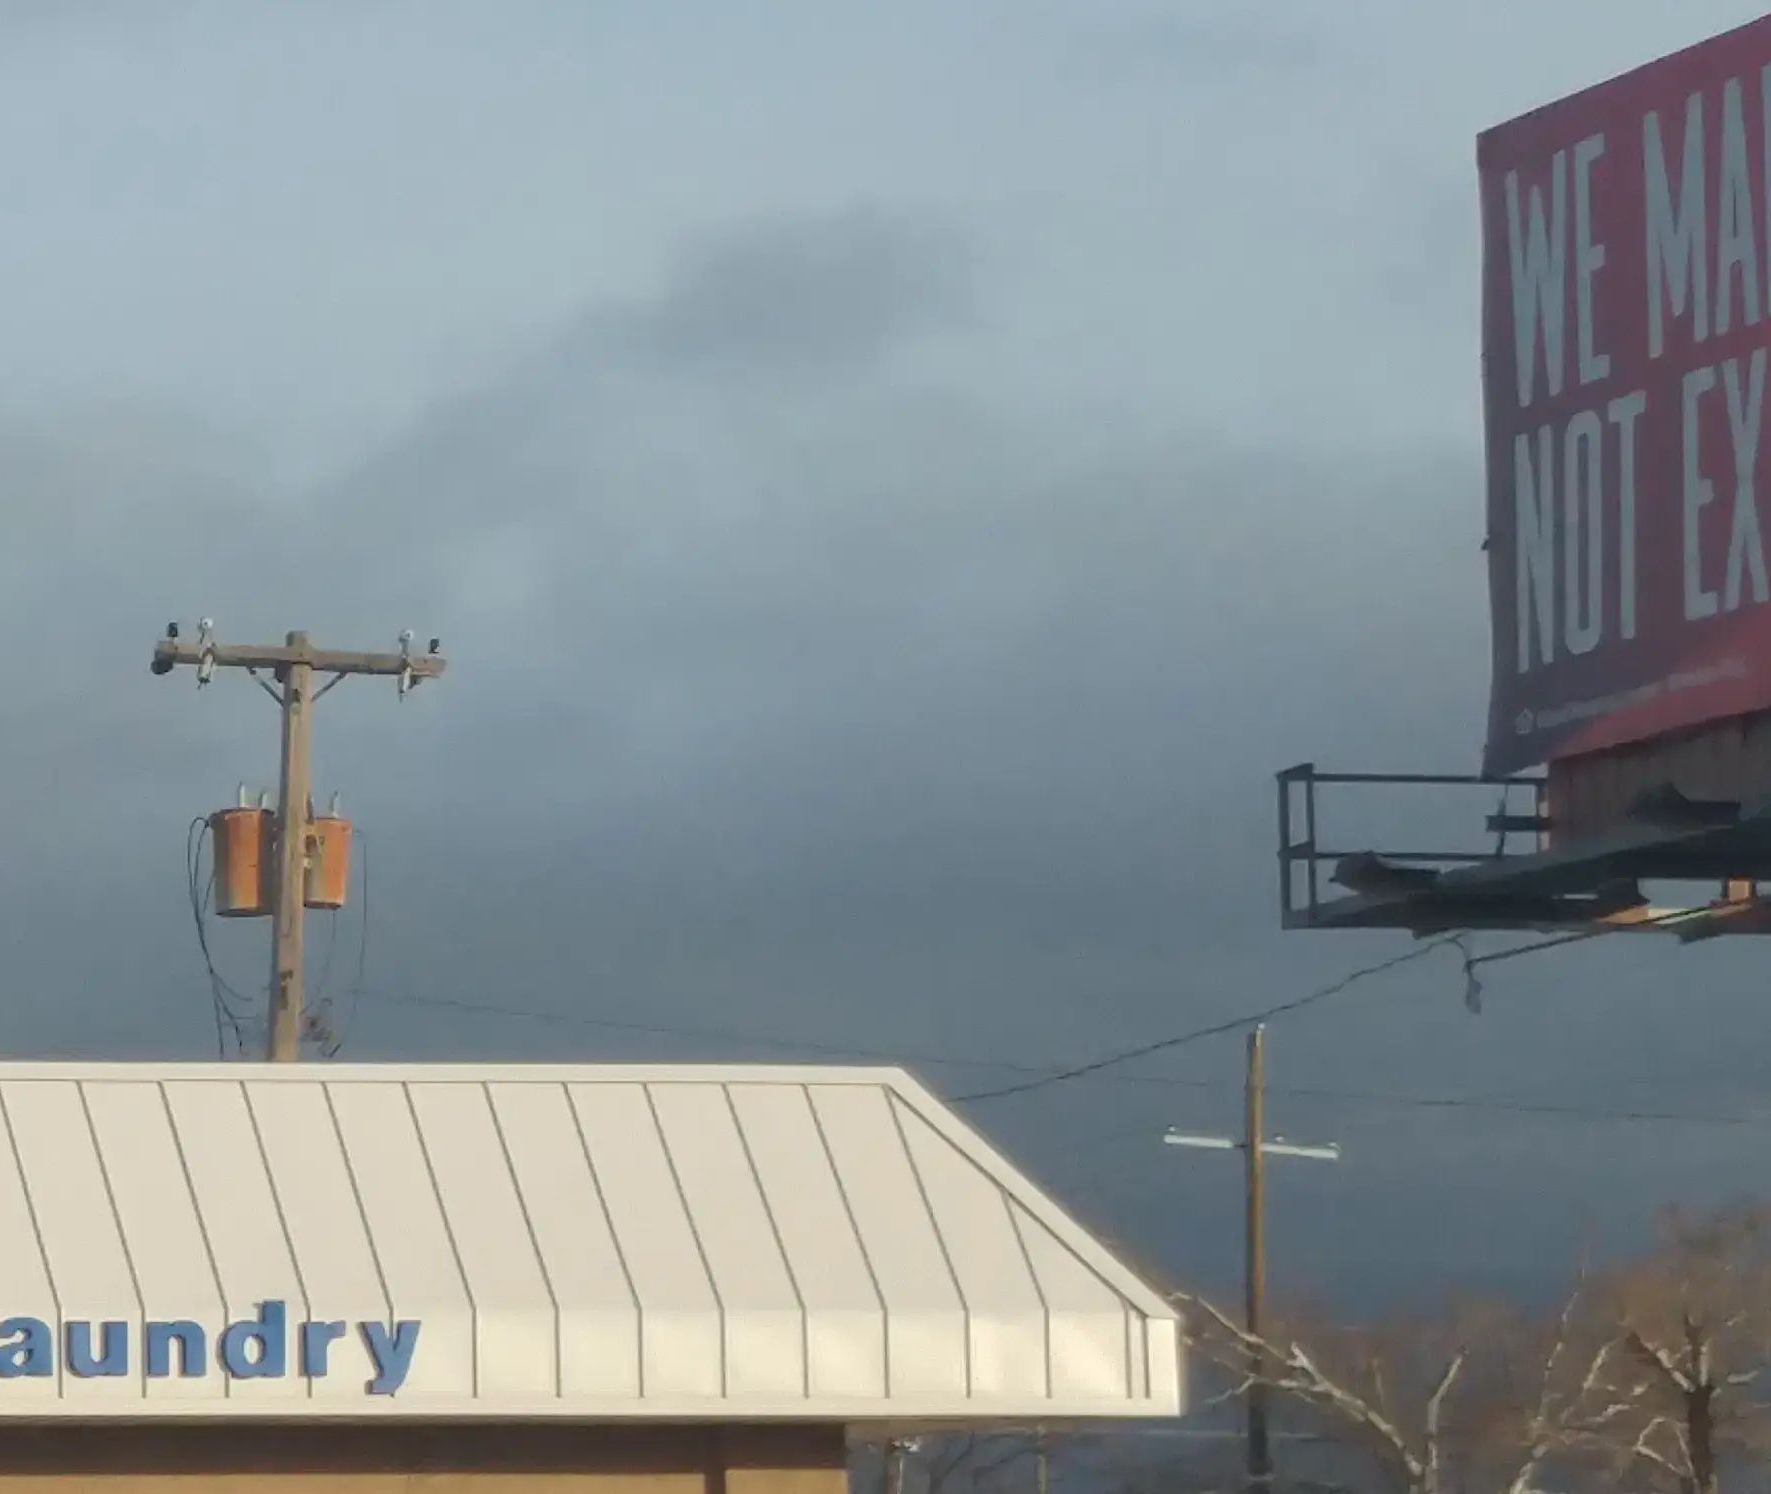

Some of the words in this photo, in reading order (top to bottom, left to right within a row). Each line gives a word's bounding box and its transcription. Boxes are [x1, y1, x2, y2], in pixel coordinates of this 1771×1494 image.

[1505, 132, 1610, 407] WE
[1644, 60, 1771, 359] MA
[1515, 389, 1647, 674] NOT
[1682, 347, 1769, 621] EX
